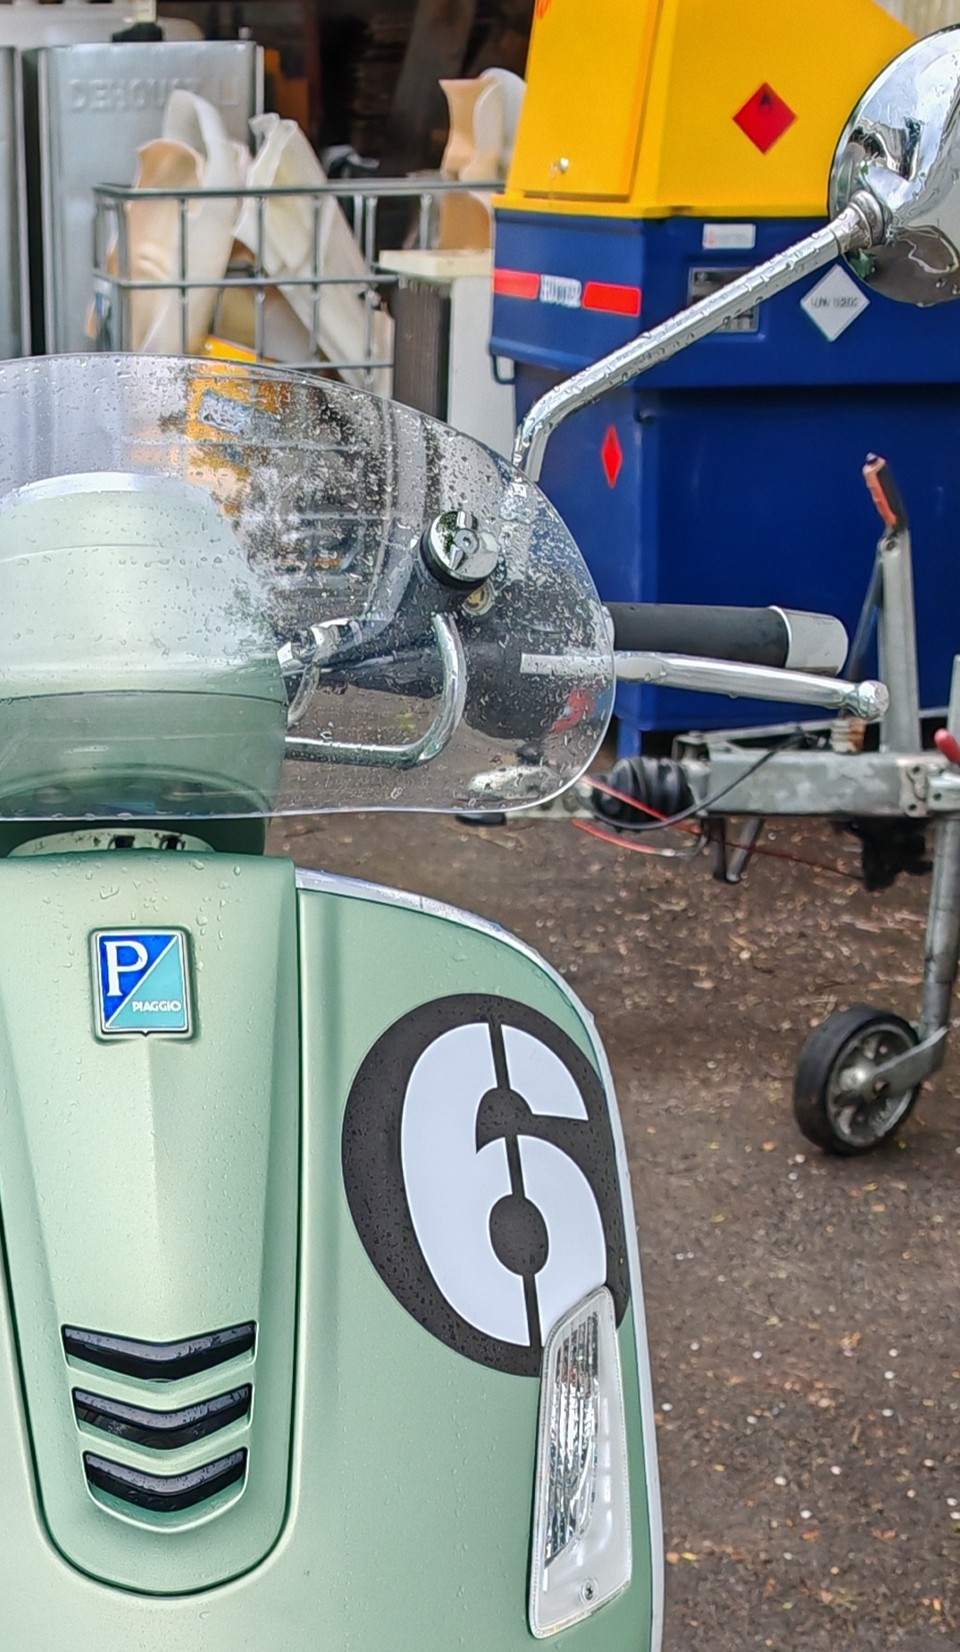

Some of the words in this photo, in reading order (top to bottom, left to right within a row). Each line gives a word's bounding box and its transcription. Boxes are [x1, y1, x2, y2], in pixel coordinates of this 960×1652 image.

[103, 940, 148, 997] P
[132, 1000, 182, 1012] PIAGGIO
[401, 1022, 607, 1347] 6
